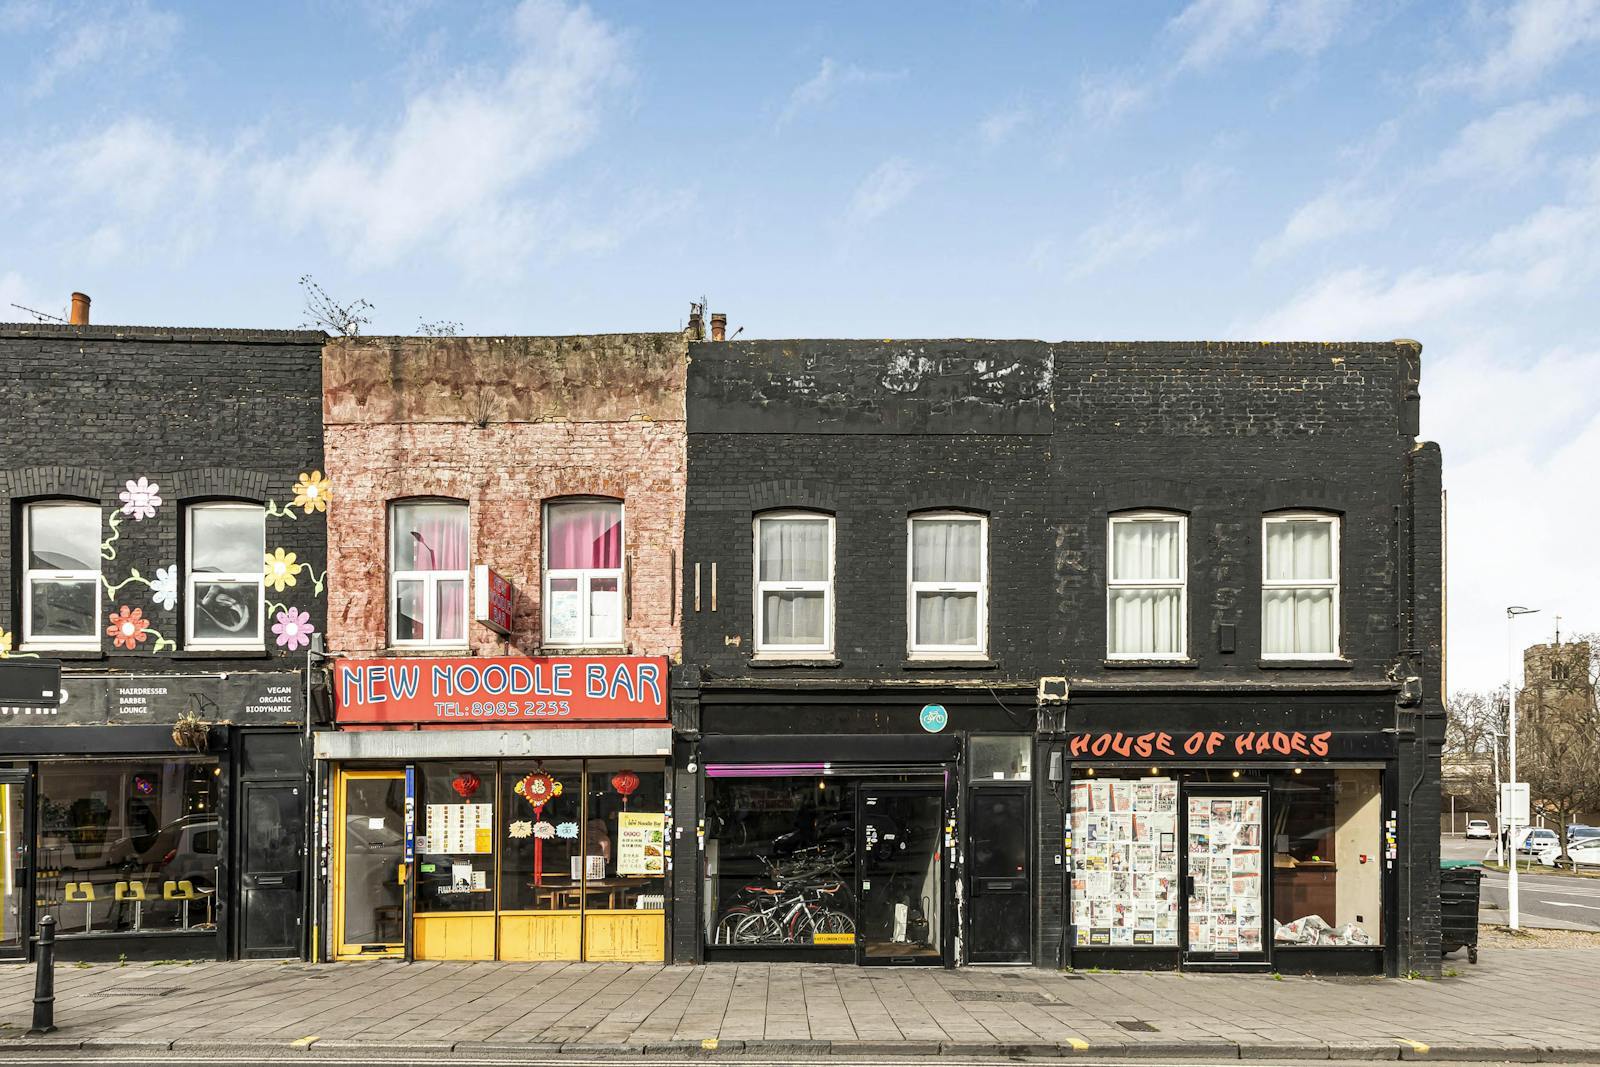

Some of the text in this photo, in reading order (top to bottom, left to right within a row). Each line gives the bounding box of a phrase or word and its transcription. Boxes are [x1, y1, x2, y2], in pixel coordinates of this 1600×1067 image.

[341, 663, 663, 707] NEW NOODLE BAR
[119, 687, 168, 695] HAIRDRESSER
[267, 686, 292, 694] VEGAN
[119, 706, 148, 714] LOUNGE
[245, 705, 292, 713] BIODYNAMIC
[523, 701, 571, 717] 2233
[1069, 730, 1333, 758] HOUSE OF HADES
